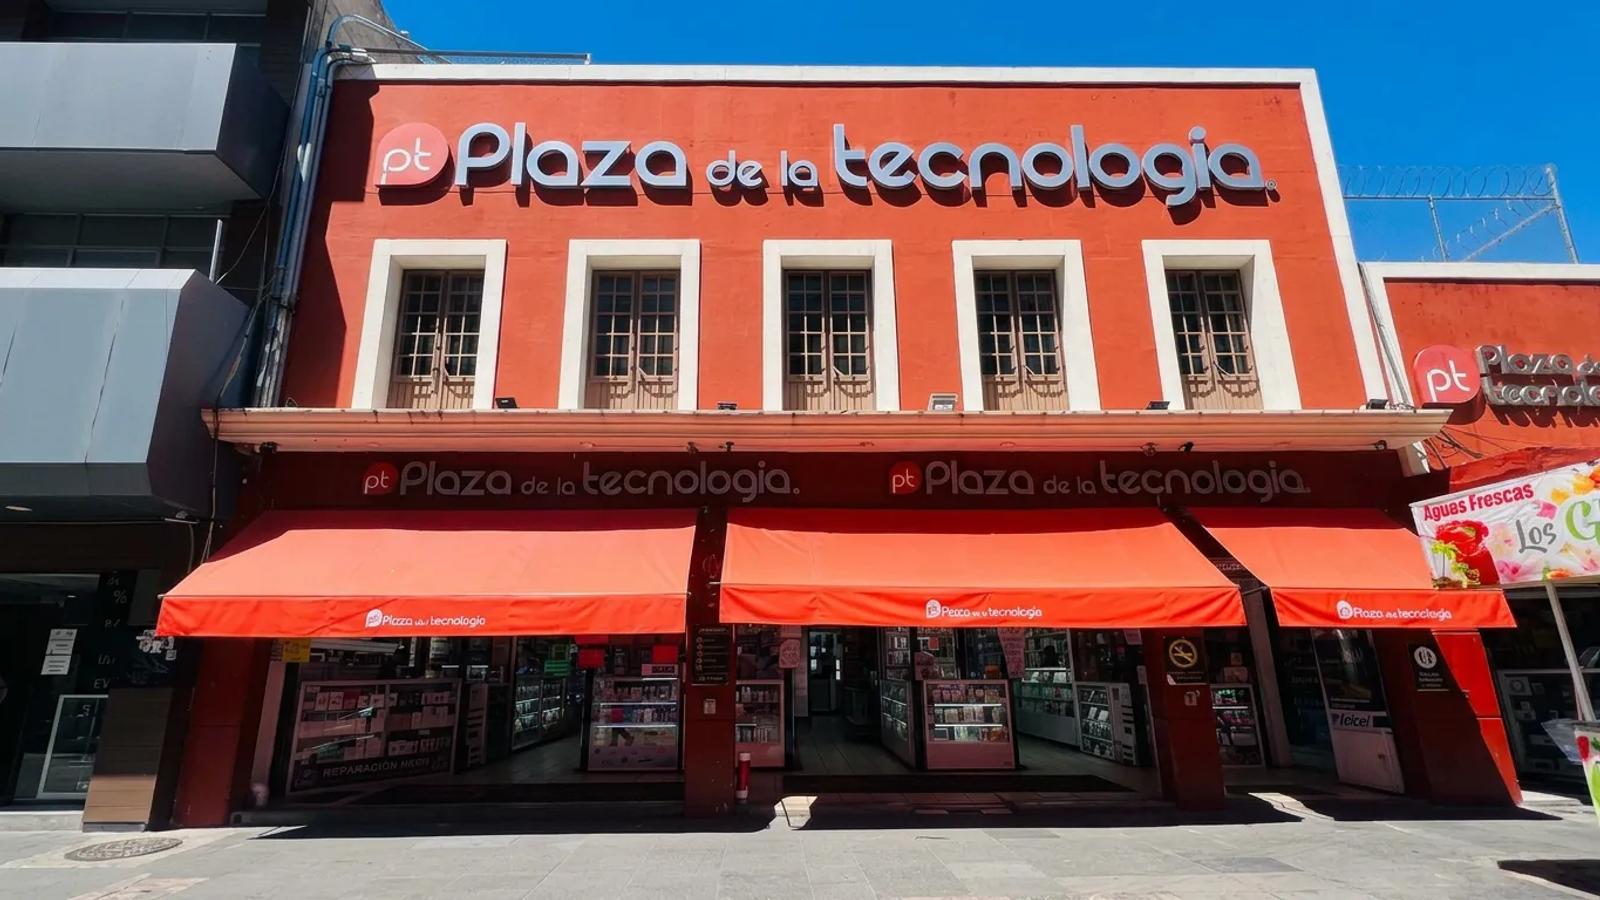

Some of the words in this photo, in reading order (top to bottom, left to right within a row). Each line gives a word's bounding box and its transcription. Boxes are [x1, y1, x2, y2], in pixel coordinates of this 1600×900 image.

[381, 137, 432, 185] pt
[454, 122, 687, 188] Plaza
[706, 150, 763, 188] de
[780, 150, 819, 190] la
[833, 123, 1266, 208] tecnologia
[1475, 344, 1573, 375] Plaza
[1427, 360, 1470, 402] pt
[364, 470, 390, 495] pt
[400, 461, 512, 496] Plaza
[521, 476, 549, 495] de
[557, 476, 576, 495] la
[583, 460, 791, 503] tecnologia
[891, 470, 915, 494] pt
[925, 460, 1035, 495] Plaza
[1043, 475, 1070, 495] de
[1077, 475, 1097, 495] la
[1100, 460, 1306, 503] tecnologia
[1423, 499, 1467, 522] Aguas
[1468, 483, 1535, 512] Frescas
[1515, 519, 1557, 554] Los
